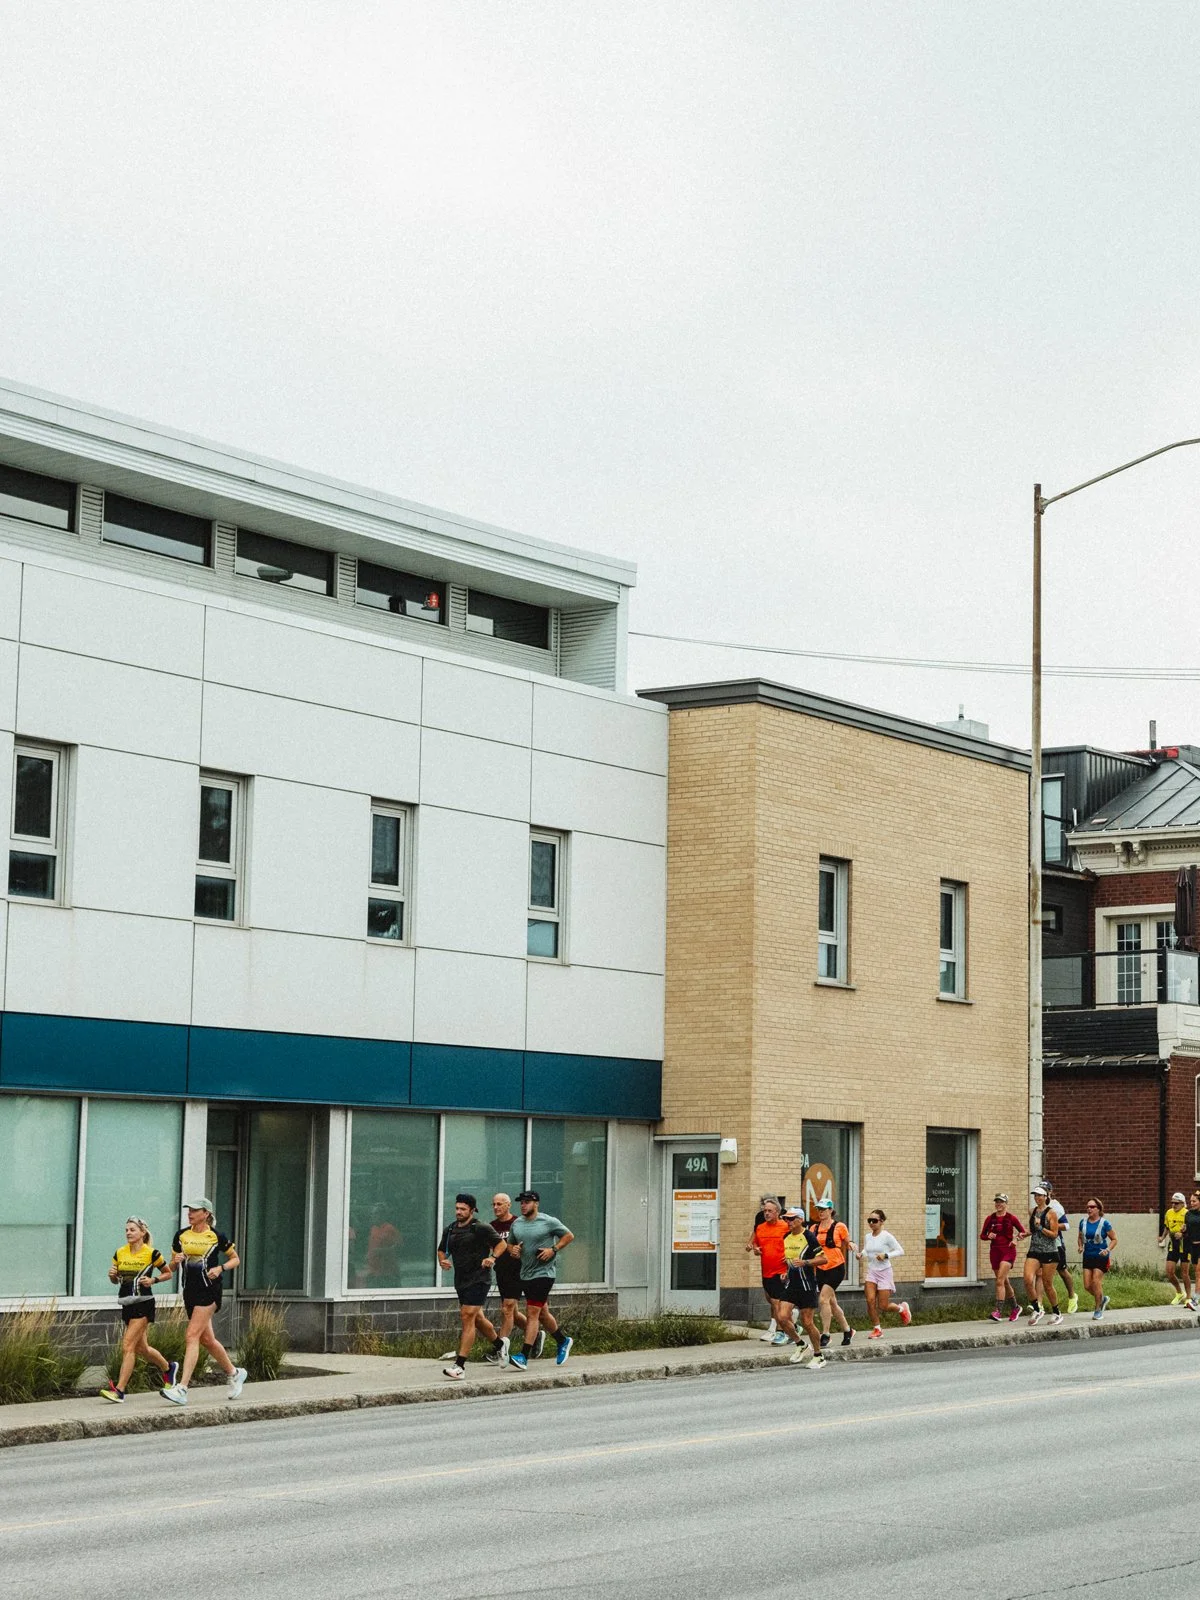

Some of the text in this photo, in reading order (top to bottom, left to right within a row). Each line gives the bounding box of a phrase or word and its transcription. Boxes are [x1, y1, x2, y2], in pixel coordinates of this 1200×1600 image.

[685, 1157, 708, 1172] 49A
[926, 1164, 960, 1176] udio Iyengar
